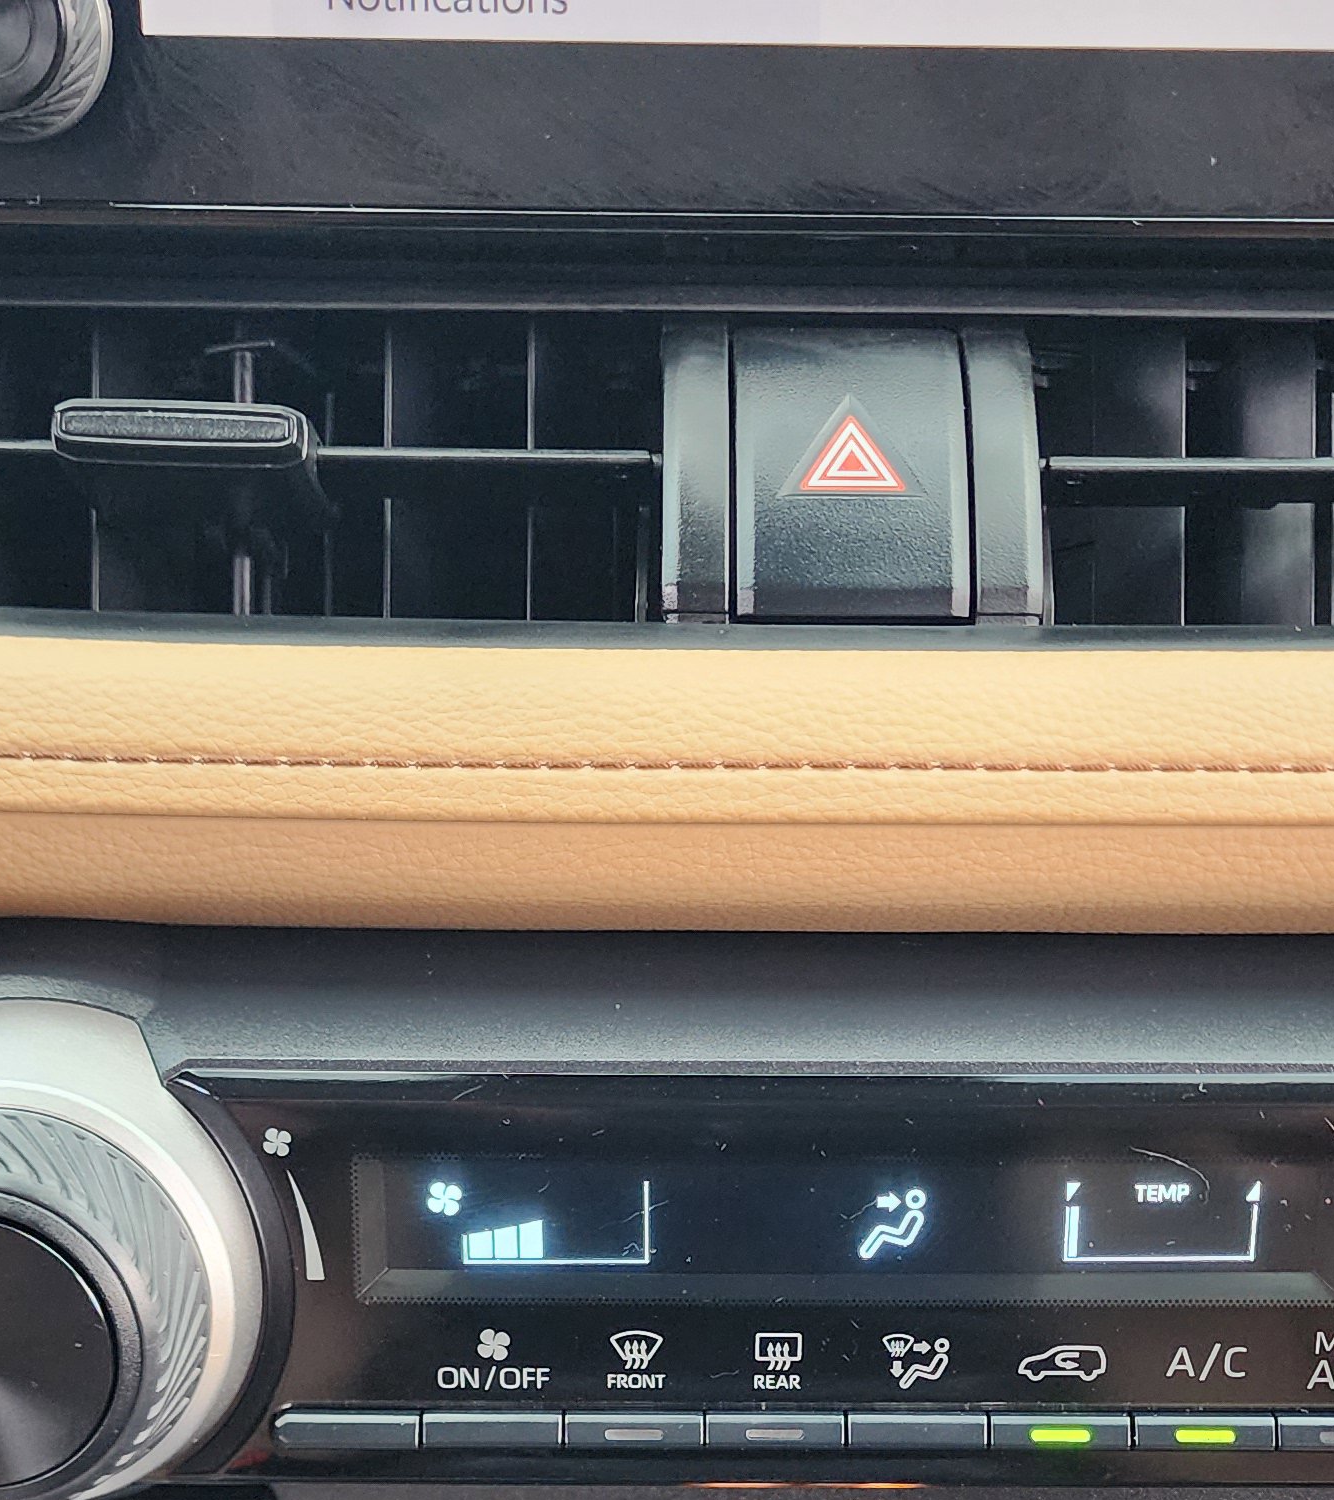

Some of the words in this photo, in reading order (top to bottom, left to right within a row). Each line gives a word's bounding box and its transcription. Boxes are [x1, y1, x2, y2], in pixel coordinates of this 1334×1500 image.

[1134, 1183, 1190, 1203] TEMP
[1167, 1342, 1248, 1383] A/C
[606, 1373, 665, 1390] FRONT
[753, 1373, 801, 1391] REAR
